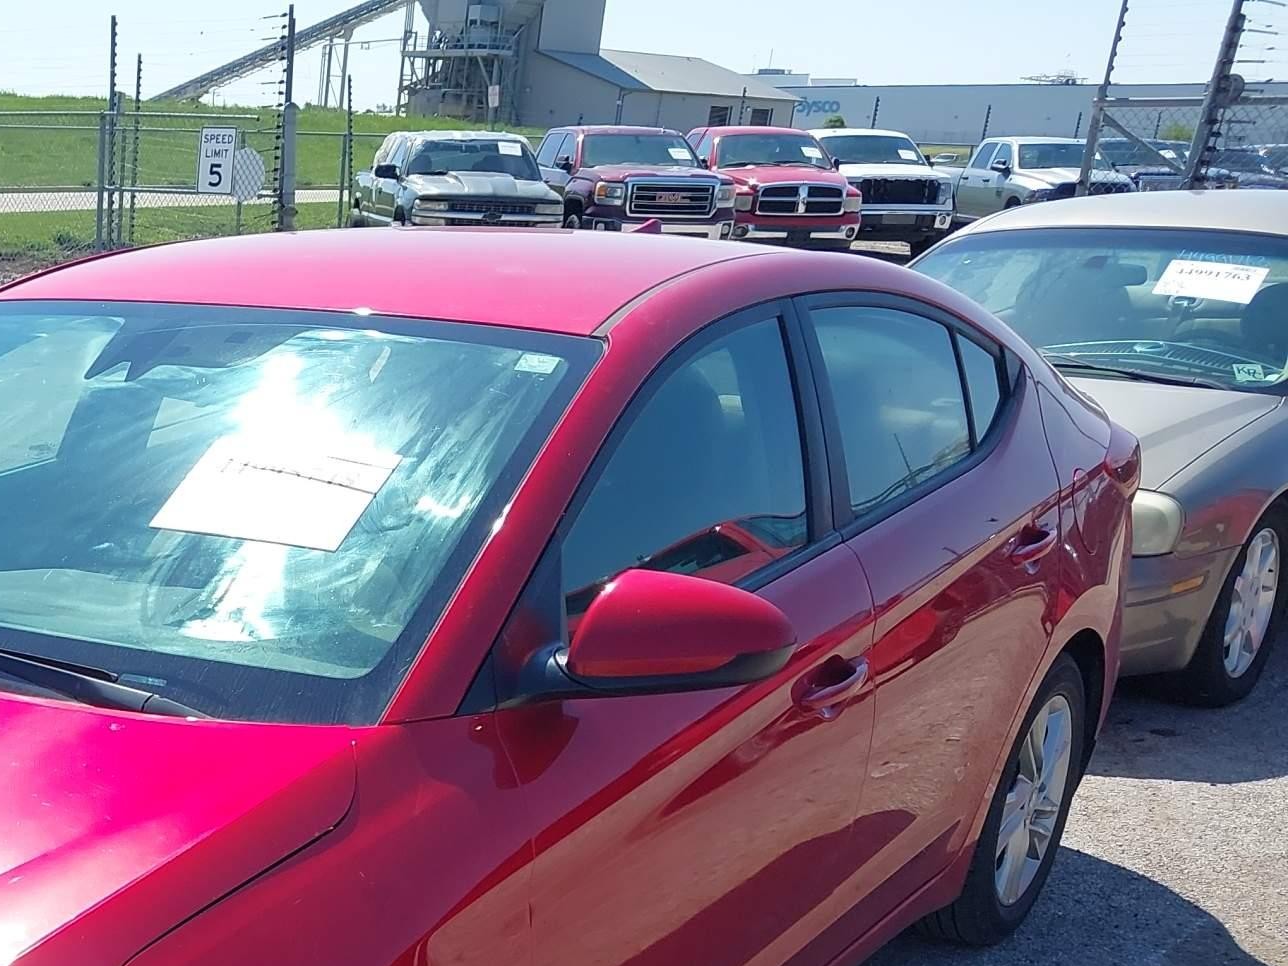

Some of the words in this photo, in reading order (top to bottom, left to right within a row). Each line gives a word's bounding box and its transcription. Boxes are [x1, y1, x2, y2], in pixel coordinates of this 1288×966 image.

[796, 96, 841, 116] Sysco
[204, 134, 233, 144] SPEED
[205, 149, 229, 159] LIMIT
[208, 163, 222, 187] 5
